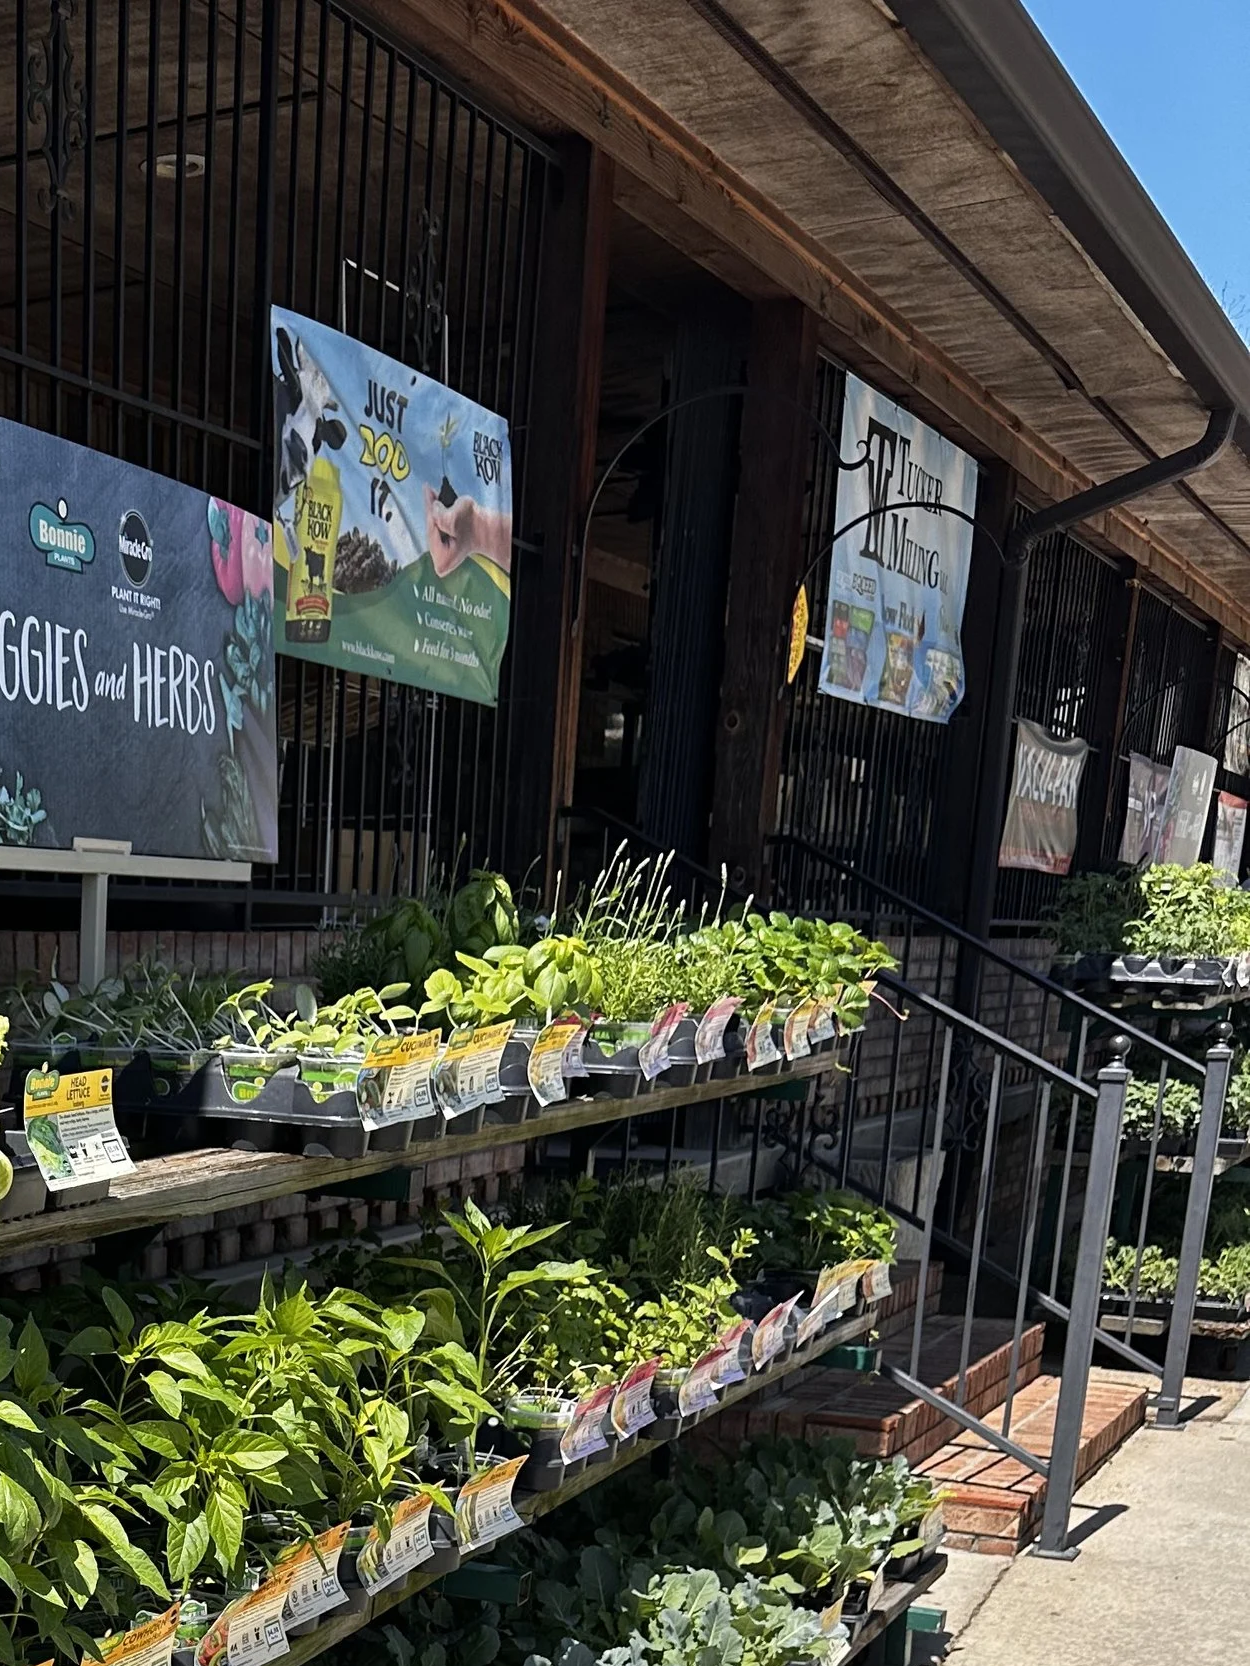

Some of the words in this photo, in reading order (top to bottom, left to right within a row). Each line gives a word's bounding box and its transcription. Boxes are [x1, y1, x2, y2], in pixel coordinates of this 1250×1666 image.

[364, 379, 409, 434] JUST
[474, 431, 503, 459] BLACK
[474, 454, 501, 485] KOW
[308, 501, 333, 521] BLACK
[370, 477, 392, 522] IT.
[39, 519, 86, 554] Bonnie
[307, 519, 332, 540] KOW
[54, 552, 75, 566] PLANTS
[111, 585, 132, 601] PLANT
[133, 592, 139, 603] IT
[94, 663, 127, 701] and
[133, 642, 215, 735] HERBS
[66, 1087, 90, 1100] LETTUCE
[71, 1076, 86, 1088] HEAD
